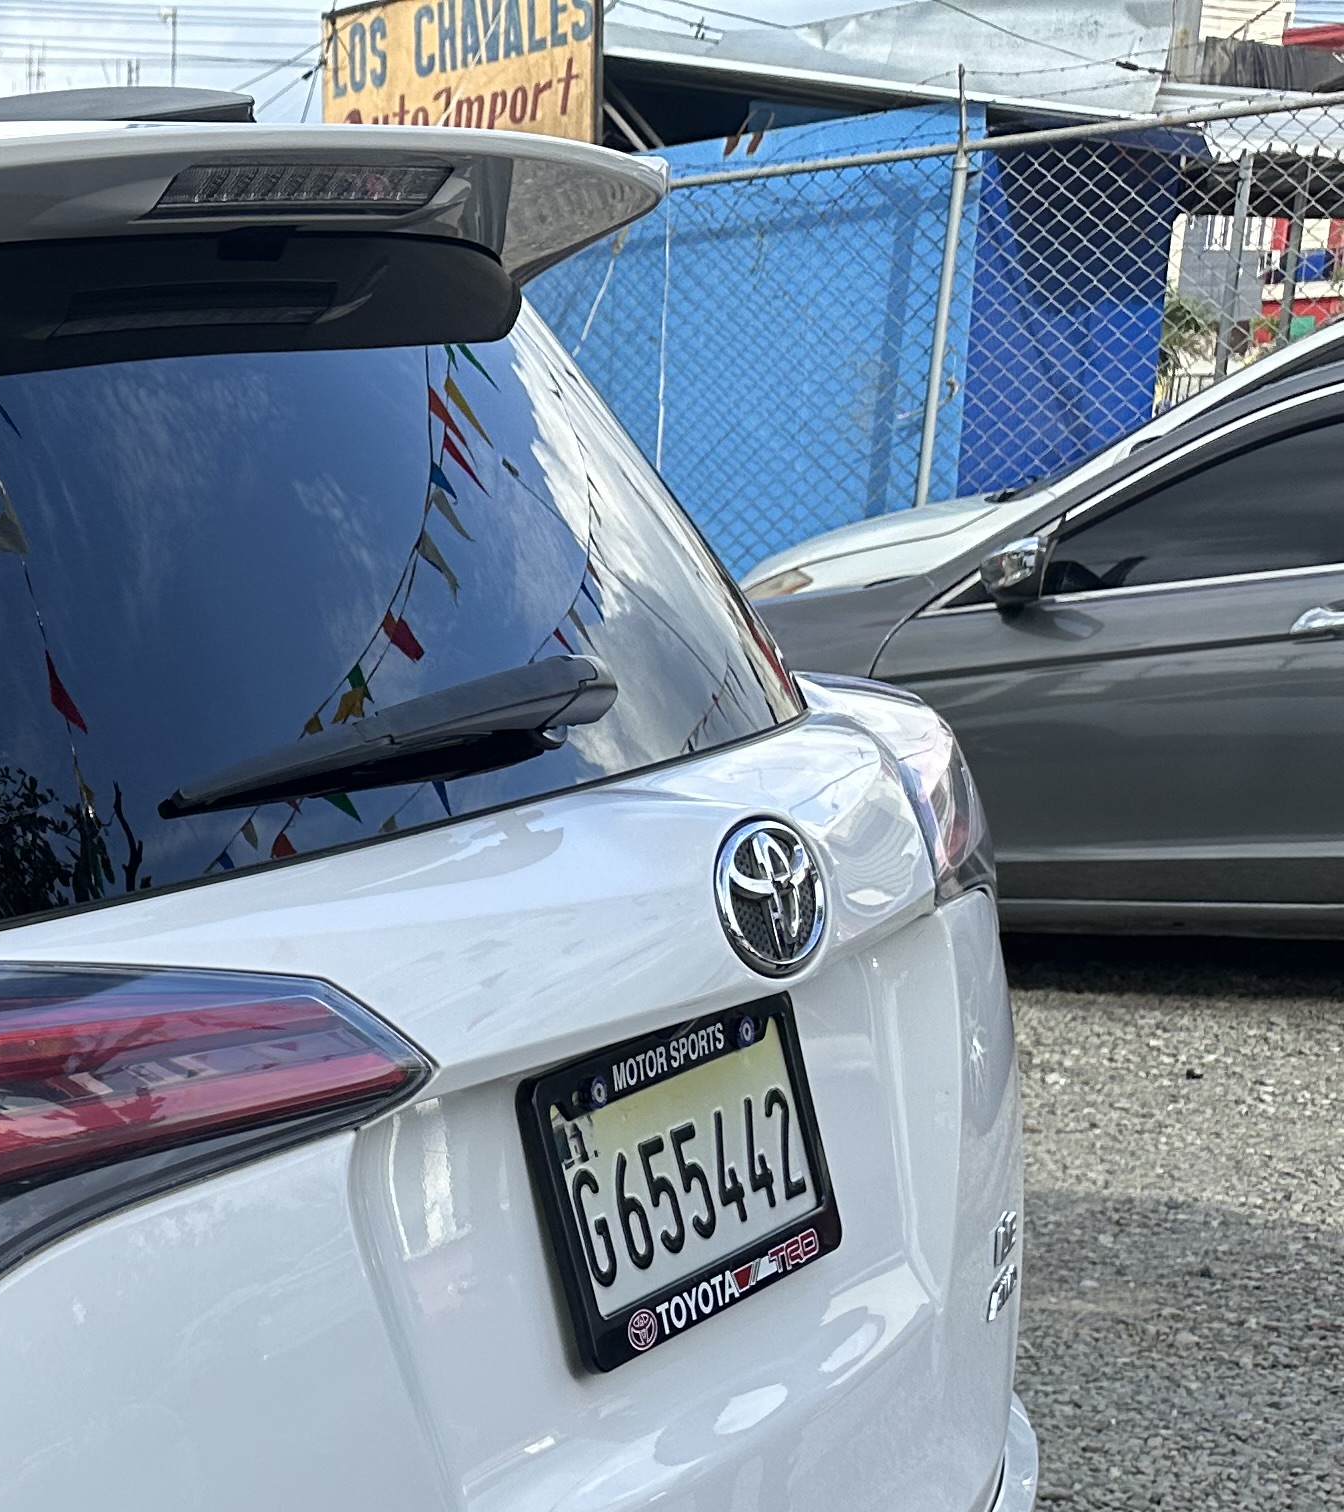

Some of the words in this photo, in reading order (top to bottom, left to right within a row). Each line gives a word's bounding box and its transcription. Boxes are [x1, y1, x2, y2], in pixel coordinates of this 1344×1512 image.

[333, 16, 387, 98] LOS
[413, 0, 593, 77] CHAVALES
[612, 1046, 668, 1092] MOTOR
[670, 1022, 725, 1068] SPORTS
[572, 1087, 807, 1287] G655442
[655, 1270, 740, 1335] TOYOTA
[768, 1228, 819, 1273] TRD
